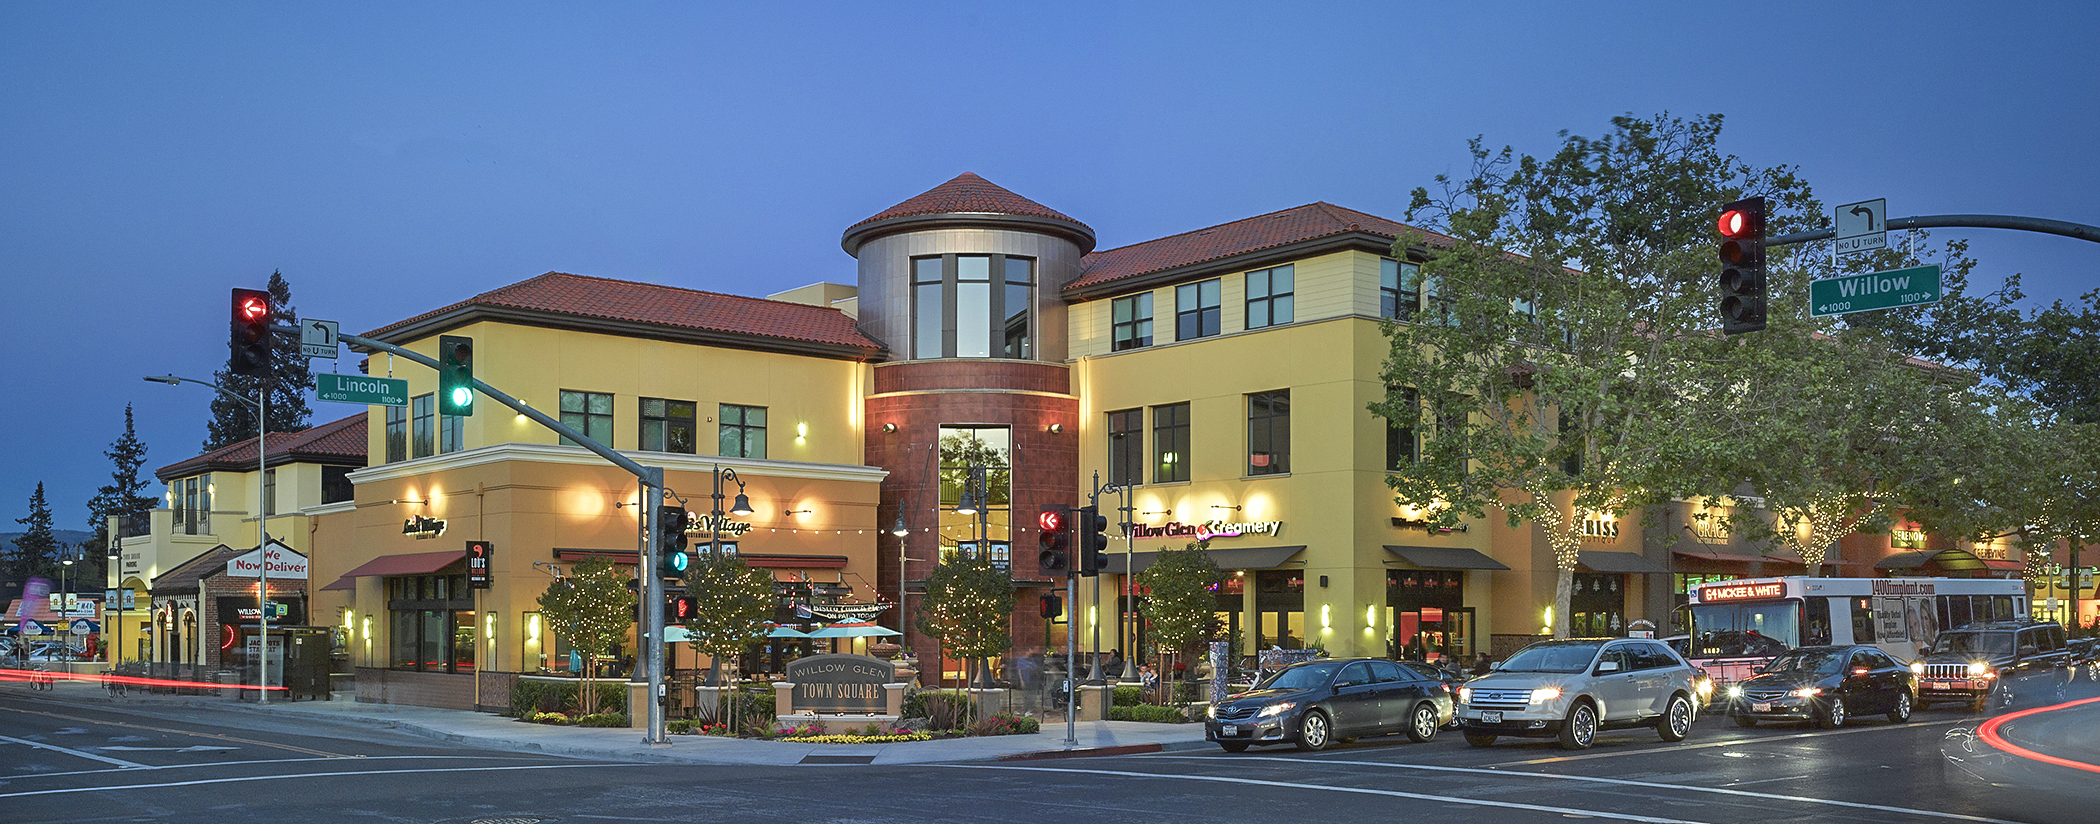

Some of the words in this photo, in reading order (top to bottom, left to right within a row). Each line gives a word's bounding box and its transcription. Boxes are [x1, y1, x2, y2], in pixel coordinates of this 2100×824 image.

[1852, 239, 1860, 249] U
[1863, 236, 1884, 246] TURN
[1838, 275, 1911, 298] Willow
[1900, 292, 1921, 304] 1100
[1828, 301, 1851, 312] 1000
[312, 346, 320, 354] U
[321, 348, 336, 356] TURN
[337, 376, 389, 394] Lincoln
[330, 392, 347, 400] 1000
[381, 396, 396, 404] 1100
[1165, 521, 1196, 537] Glen
[1211, 520, 1281, 537] Creamery
[1580, 536, 1616, 544] OUTIQUE
[264, 550, 280, 560] We
[236, 560, 261, 570] Now
[265, 561, 306, 573] Deliver
[1705, 588, 1718, 601] 64
[1717, 587, 1747, 598] MCKEE
[1747, 586, 1755, 597] &
[1755, 584, 1781, 596] WHITE
[1871, 580, 1936, 595] 1400implant.com
[794, 663, 846, 677] WILLOW
[852, 664, 887, 679] GLEN
[801, 682, 833, 699] TOWN
[837, 682, 880, 699] SQUARE
